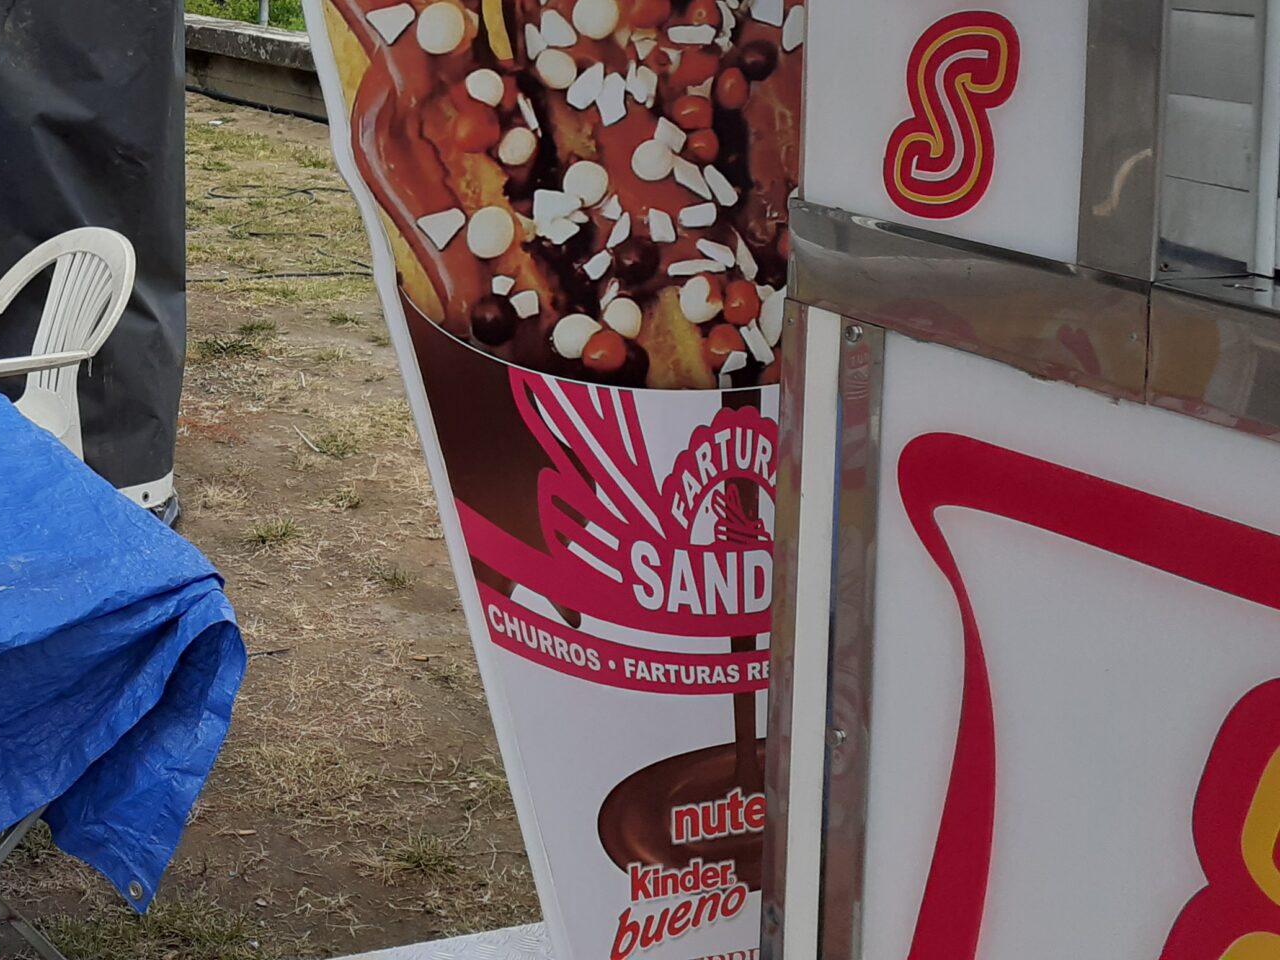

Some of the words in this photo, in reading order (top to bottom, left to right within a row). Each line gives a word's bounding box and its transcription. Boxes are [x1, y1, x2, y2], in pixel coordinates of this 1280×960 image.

[630, 540, 773, 616] SAND
[487, 603, 601, 672] CHURROS
[623, 657, 740, 685] FARTURAS
[630, 861, 733, 902] Kinder
[610, 885, 747, 960] bueno
